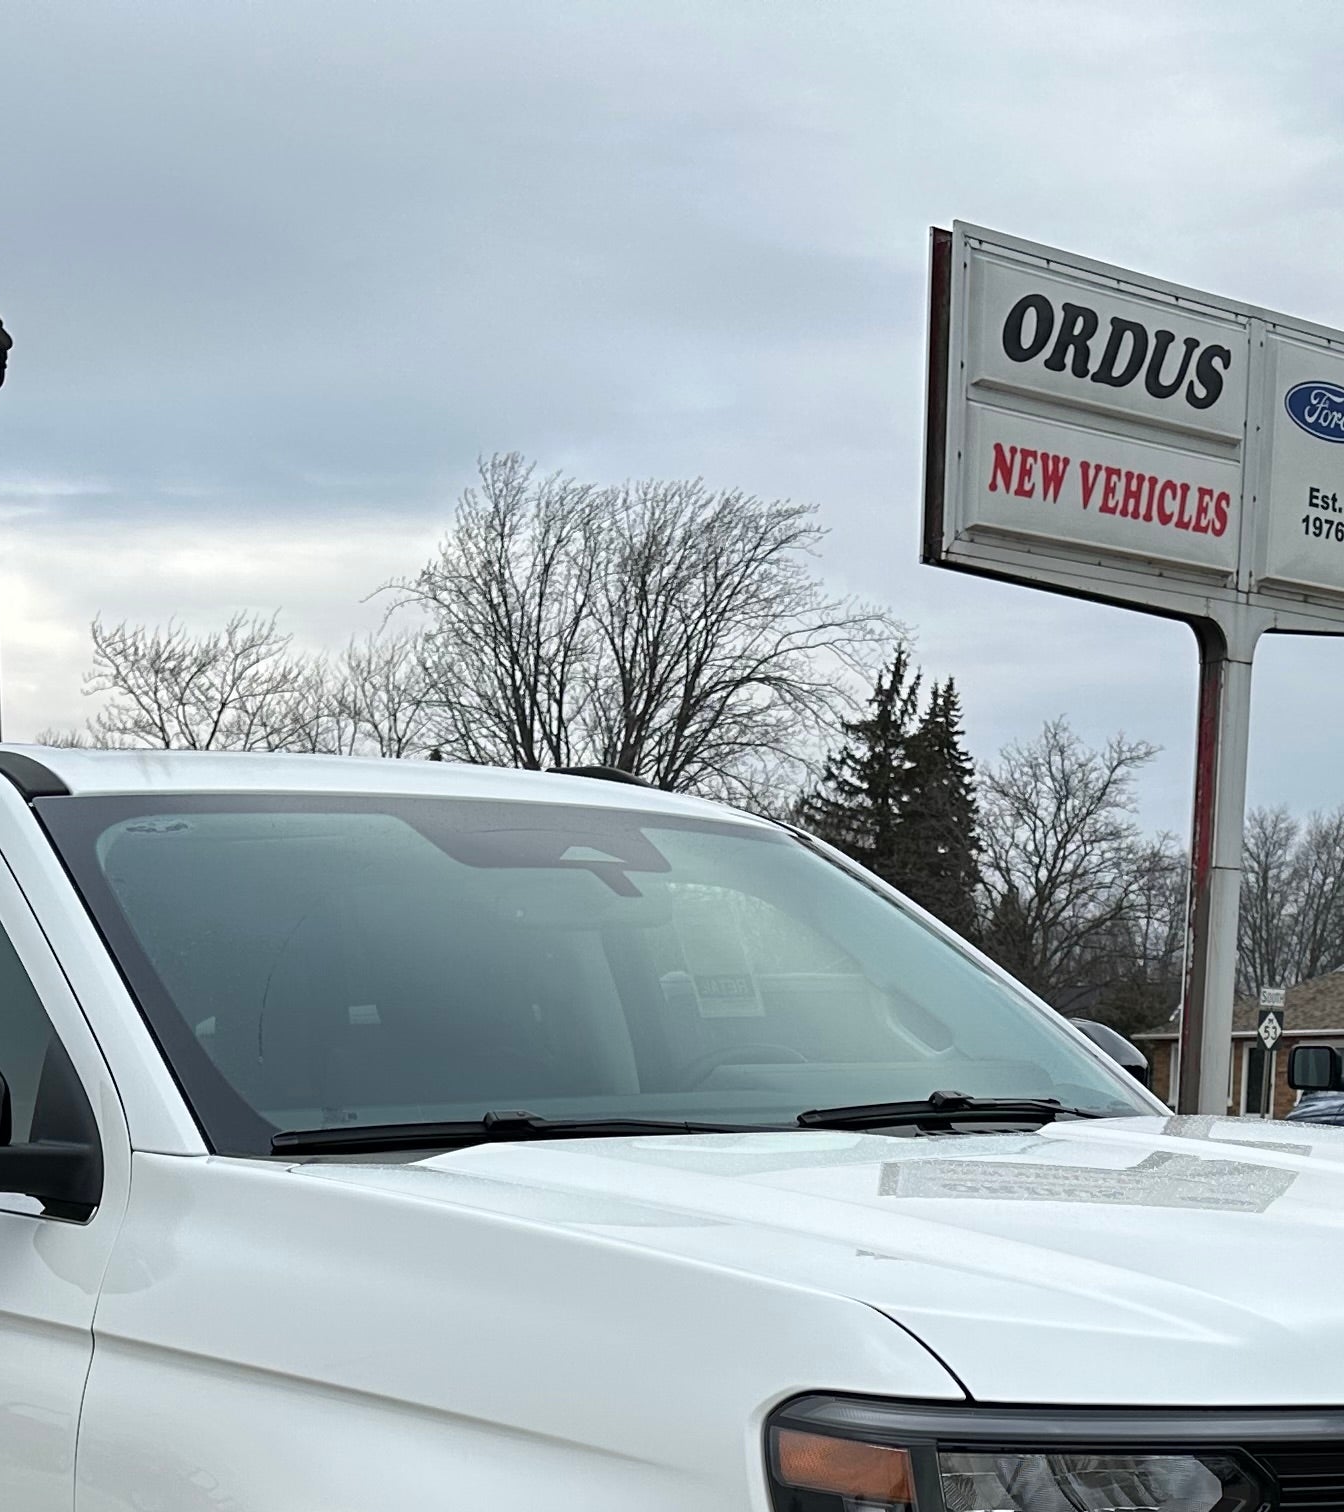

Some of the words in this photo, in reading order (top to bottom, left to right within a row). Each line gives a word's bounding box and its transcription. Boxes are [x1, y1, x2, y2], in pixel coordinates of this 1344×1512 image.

[1003, 294, 1231, 409] ORDUS
[989, 443, 1070, 503] NEW
[1079, 461, 1231, 537] VEHICLES
[1309, 487, 1343, 513] Est.
[1302, 515, 1344, 542] 1976
[1264, 1026, 1277, 1041] 53
